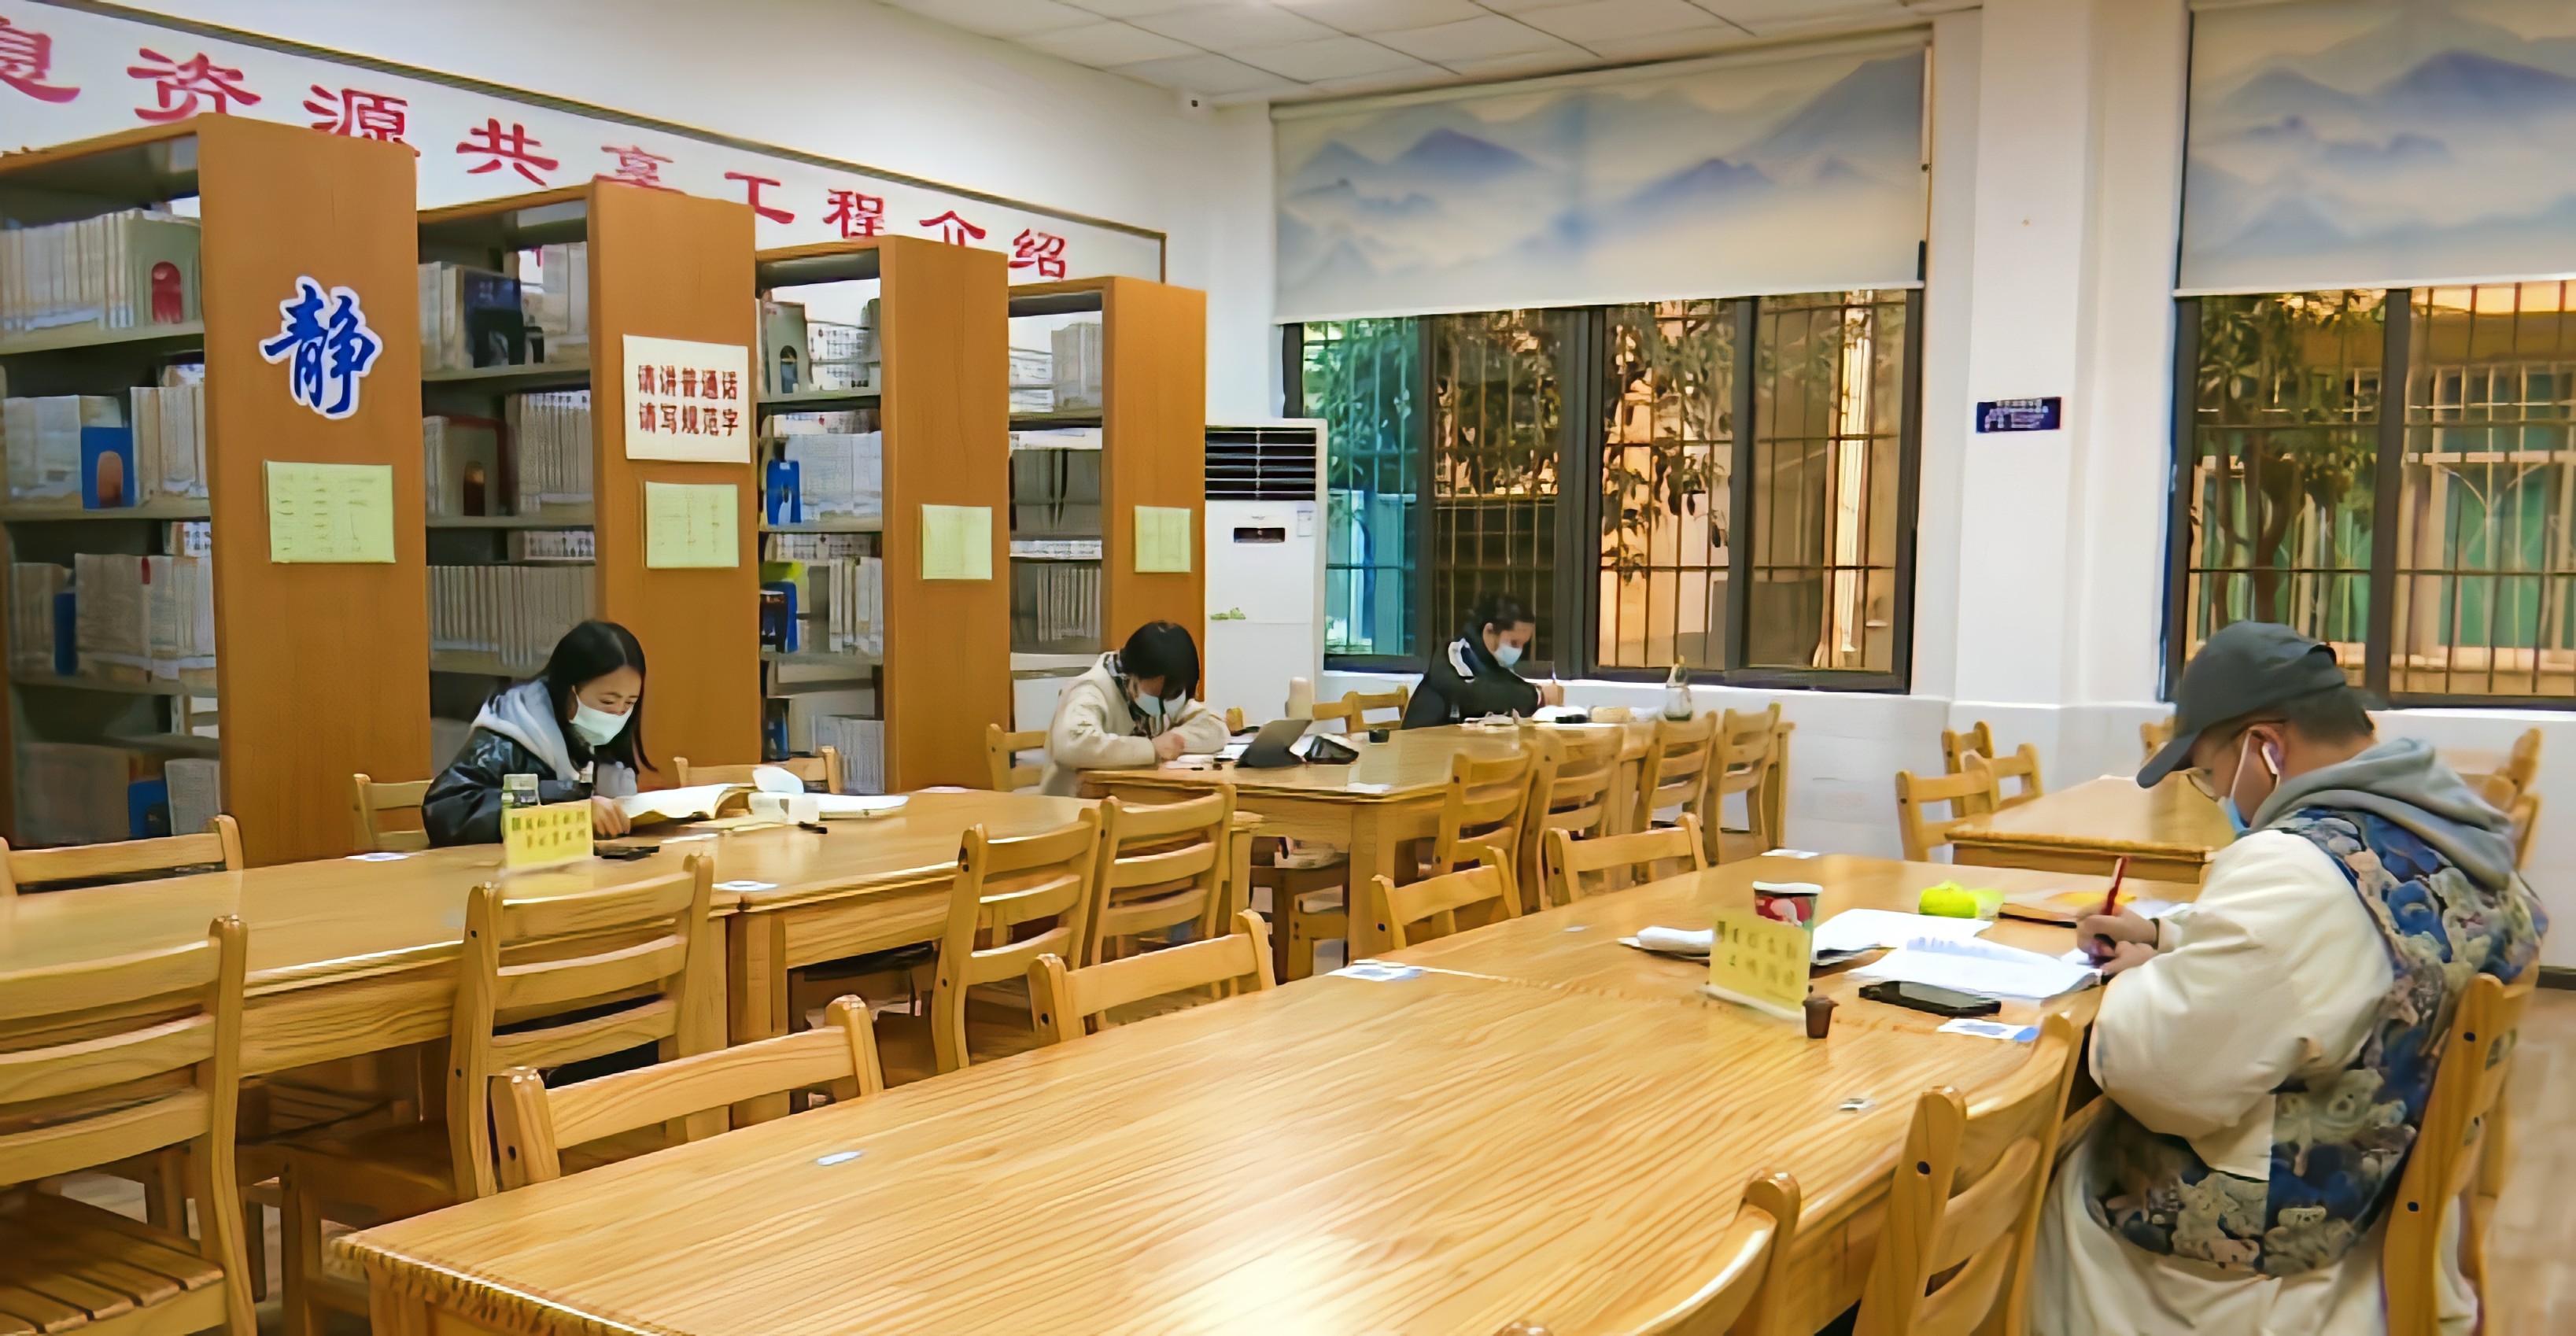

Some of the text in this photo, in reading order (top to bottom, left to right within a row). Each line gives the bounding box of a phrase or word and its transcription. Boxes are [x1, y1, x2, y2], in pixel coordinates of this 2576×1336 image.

[264, 282, 376, 415] 静
[638, 364, 738, 400] 请讲普通话
[639, 401, 740, 437] 请写规范字
